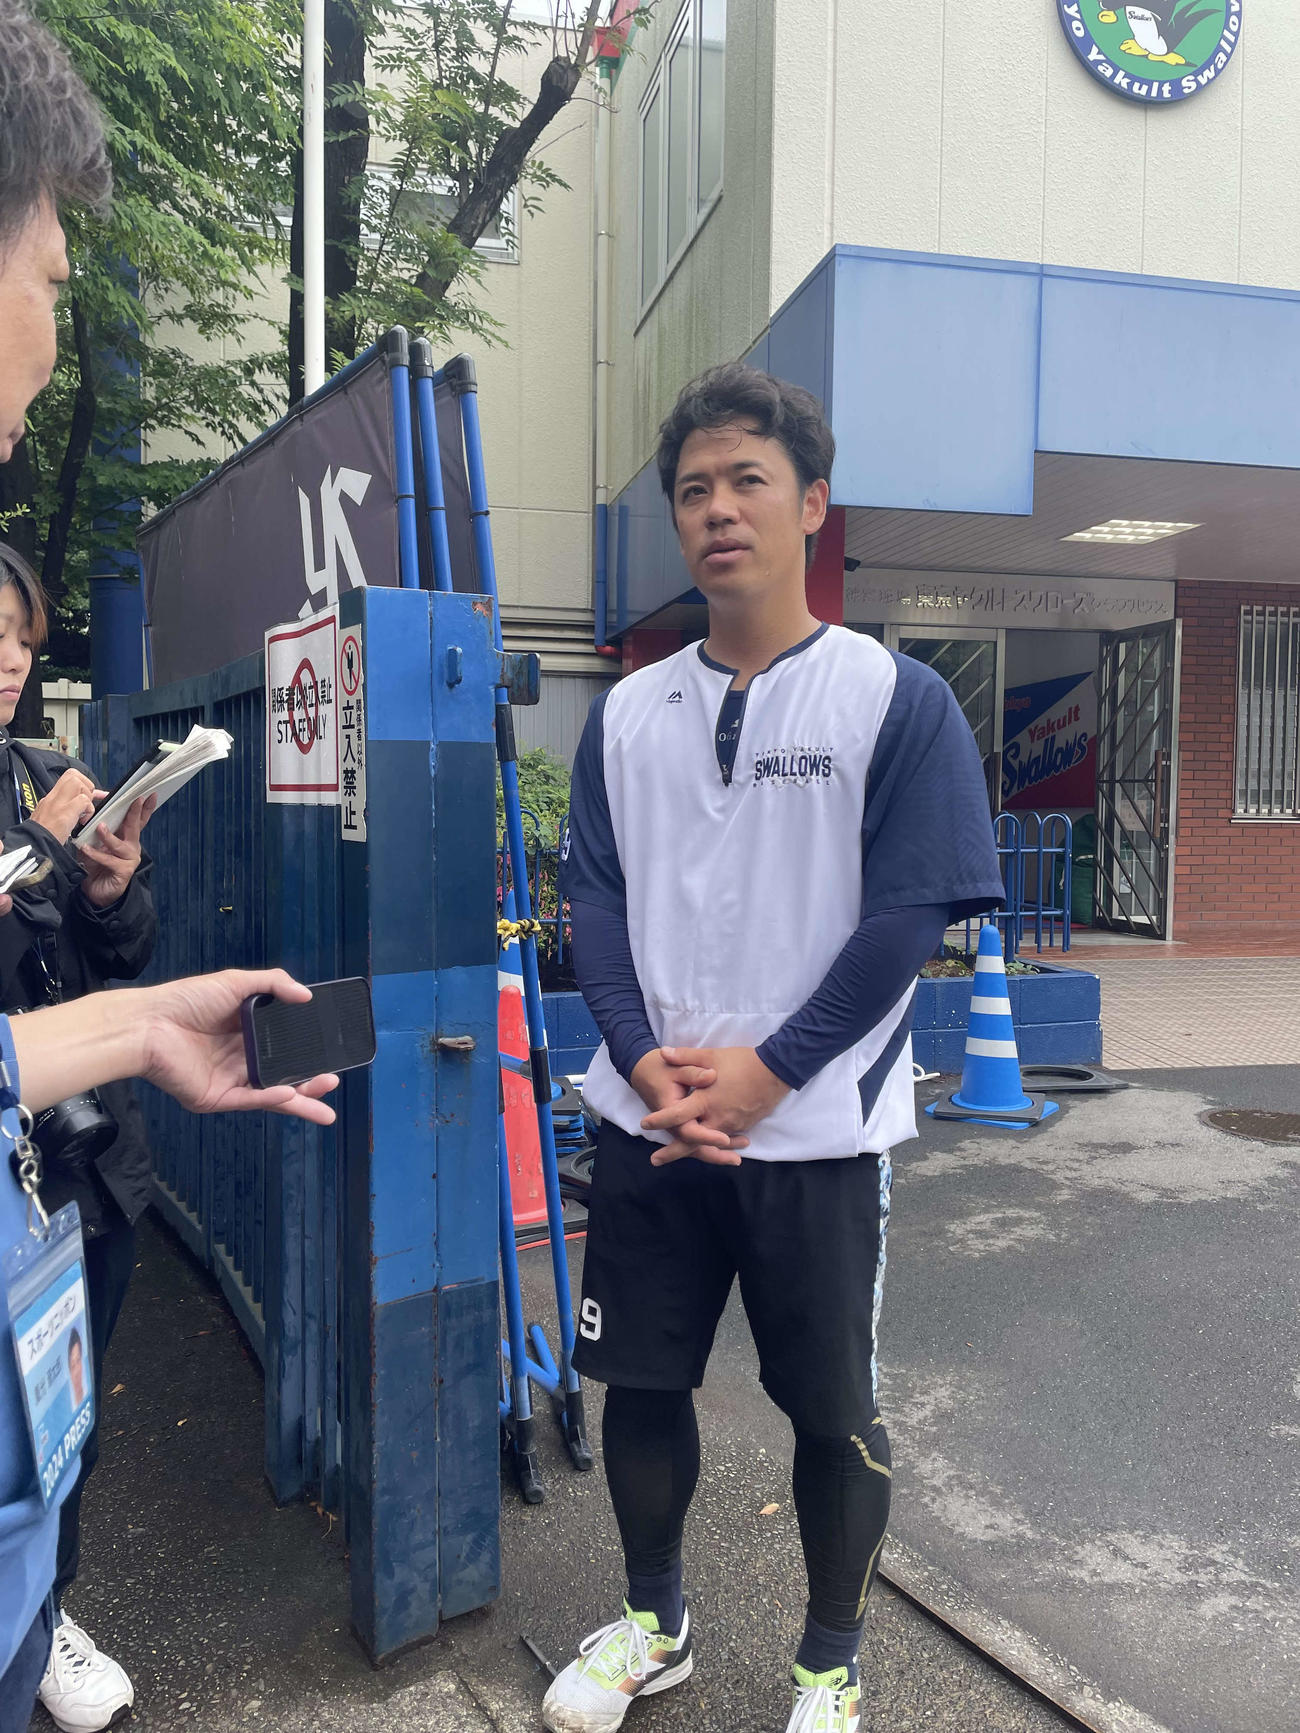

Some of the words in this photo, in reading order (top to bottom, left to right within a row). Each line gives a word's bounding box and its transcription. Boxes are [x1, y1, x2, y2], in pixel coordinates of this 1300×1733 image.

[1087, 44, 1172, 98] Yakult
[276, 717, 306, 745] STAFF
[1028, 703, 1081, 744] Yakult
[342, 699, 358, 831] 立入禁止
[754, 754, 832, 781] SWALLOWS
[1002, 730, 1089, 798] Swallows
[579, 1296, 603, 1342] 9
[42, 1450, 65, 1499] 2024
[63, 1400, 93, 1462] PRESS
